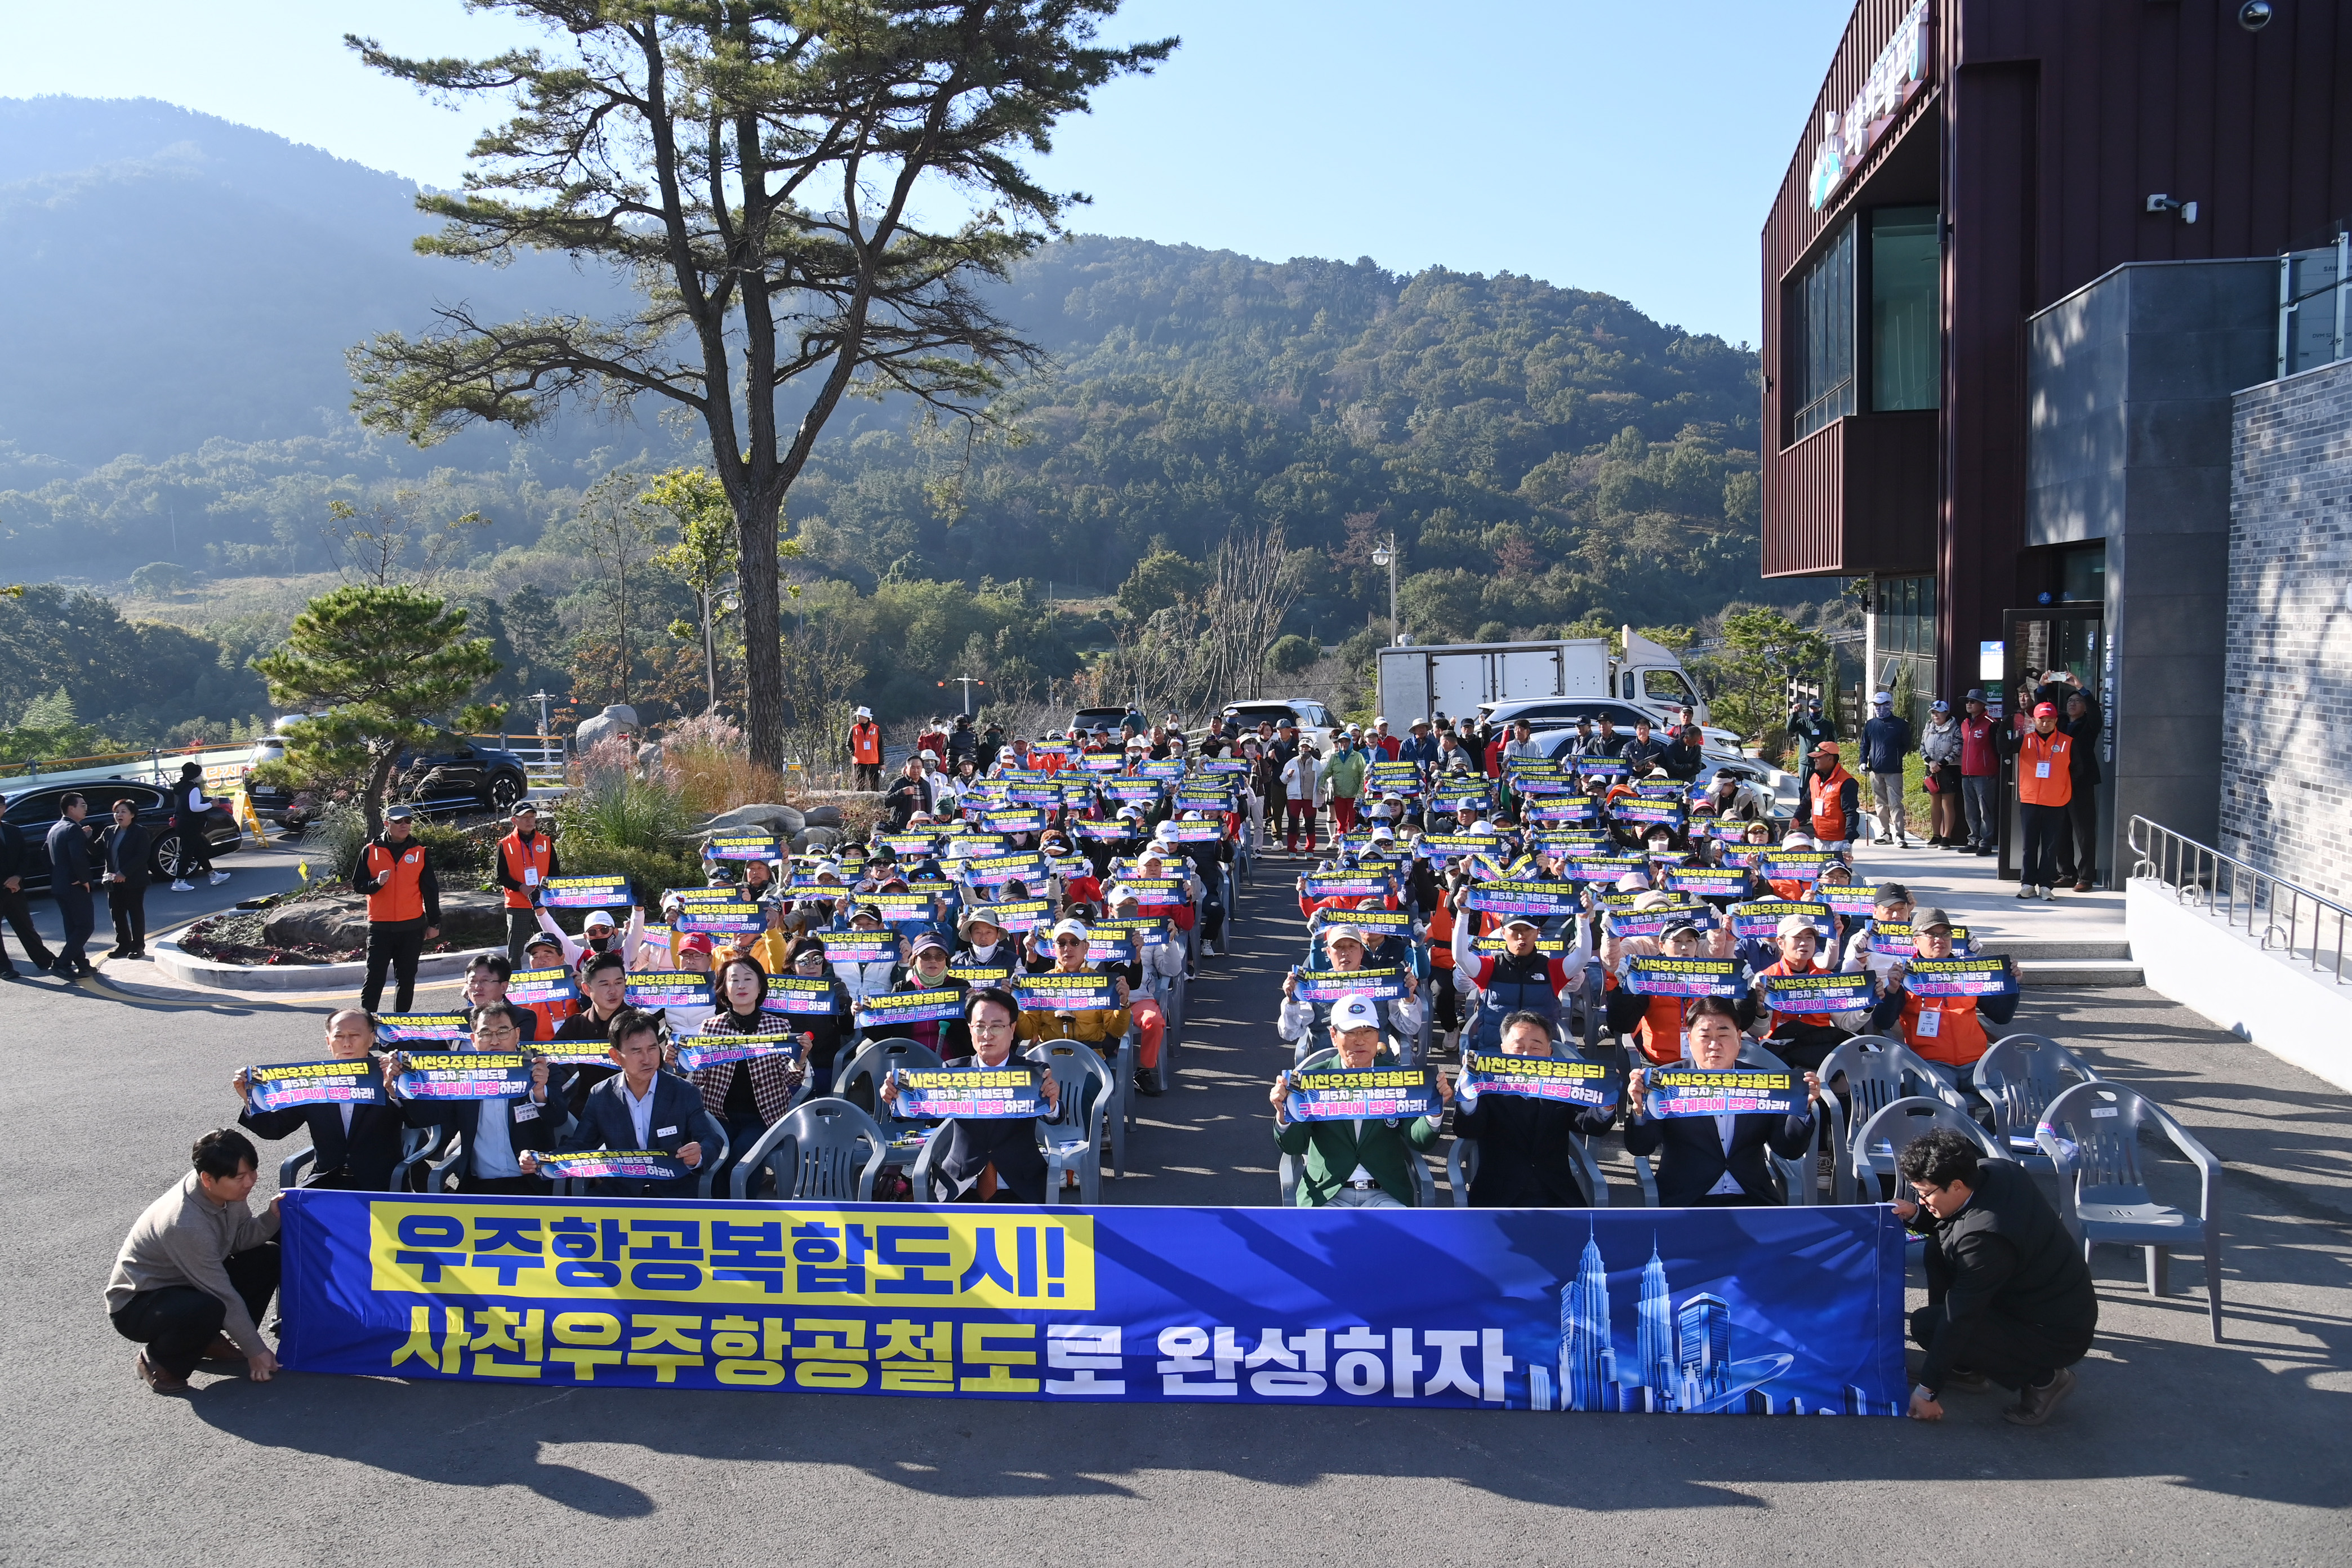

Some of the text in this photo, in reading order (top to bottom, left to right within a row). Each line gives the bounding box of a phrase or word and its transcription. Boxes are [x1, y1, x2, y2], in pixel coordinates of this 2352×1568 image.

[206, 765, 242, 788] 당신
[1426, 836, 1496, 845] 사천우주항공철도!
[972, 855, 1038, 868] 사천우주항공철도!
[1000, 865, 1029, 874] 국가철도망
[549, 876, 625, 888] 사천우주항공철도!
[973, 875, 1008, 885] 구축계획에
[559, 886, 613, 896] 제5차 국가철도망
[1477, 881, 1572, 893] 사천우주항공철도!
[1672, 884, 1743, 893] 구축계획에 반영하라!
[547, 893, 626, 906] 구축계획에 반영하라!
[1490, 891, 1558, 902] 제5차 국가철도망
[684, 905, 758, 913] 사천우주항공철도!
[1474, 900, 1573, 915] 구축계획에 반영하라!
[894, 910, 929, 919] 반영하라!
[724, 922, 759, 930] 반영하라!
[819, 933, 893, 942] 사천우주항공철도!
[824, 950, 894, 960] 축계획에 반영하라!
[1638, 960, 1732, 973] 사천우주항공철도!
[1914, 960, 2003, 972] 사천우주항공철도!
[626, 974, 706, 985] 사천우주항공철도!
[1020, 977, 1107, 988] 사천우주항공철도!
[1317, 977, 1382, 988] 제5차 국가철도망
[1651, 972, 1719, 982] 제5차 국가철도망
[1775, 975, 1865, 989] 사천우주항공철도!
[1928, 971, 1990, 982] 제5차 국가철도망
[660, 985, 694, 994] 국가철도망
[767, 977, 829, 991] 우주항공철도!
[1636, 981, 1735, 995] 구축계획에 반영하라!
[1914, 980, 2003, 995] 구축계획에 반영하라!
[527, 987, 569, 1001] 반영하라!
[1056, 988, 1094, 996] 국가철도망
[1303, 988, 1352, 1000] 구축계획에
[1788, 987, 1854, 1000] 제5차 국가철도망
[627, 993, 709, 1005] 구축계획에 반영하라!
[871, 991, 959, 1008] 사천우주항공철도!
[1020, 996, 1110, 1008] 구축계획에 반영하라!
[1775, 996, 1869, 1012] 구축계획에 반영하라!
[789, 1000, 830, 1012] 반영하라!
[907, 1003, 945, 1012] 국가철도망
[867, 1006, 959, 1024] 구축계획에 반영하라!
[703, 1045, 729, 1053] 제5차
[412, 1055, 523, 1069] 사천우주항공철도!
[688, 1050, 743, 1067] 구축계획에
[262, 1063, 368, 1080] 사천우주항공철도!
[1476, 1057, 1605, 1078] 사천우주항공철도!
[429, 1069, 507, 1081] 제5차 국가철도망
[910, 1072, 1031, 1087] 사천우주항공철도!
[1301, 1071, 1424, 1089] 사천우주항공철도!
[1661, 1073, 1789, 1088] 사천우주항공철도!
[281, 1075, 357, 1089] 제5차 국가철도망
[411, 1080, 527, 1095] 구축계획에 반영하라!
[265, 1086, 375, 1106] 구축계획에 반영하라!
[927, 1088, 1013, 1100] 제5차 국가철도망
[1319, 1087, 1406, 1101] 제5차 국가철도망
[1472, 1082, 1603, 1102] 구축계획에 반영하라!
[1678, 1086, 1769, 1097] 제5차 국가철도망
[910, 1099, 1035, 1114] 구축계획에 반영하라!
[1299, 1098, 1427, 1117] 구축계획에 반영하라!
[1659, 1097, 1789, 1114] 구축계획에 반영하라!
[554, 1164, 674, 1178] 구축계획에 반영하라!
[395, 1214, 1064, 1298] 우주항공복합도시!
[391, 1304, 1513, 1401] 사천우주항공철도로 완성하자
